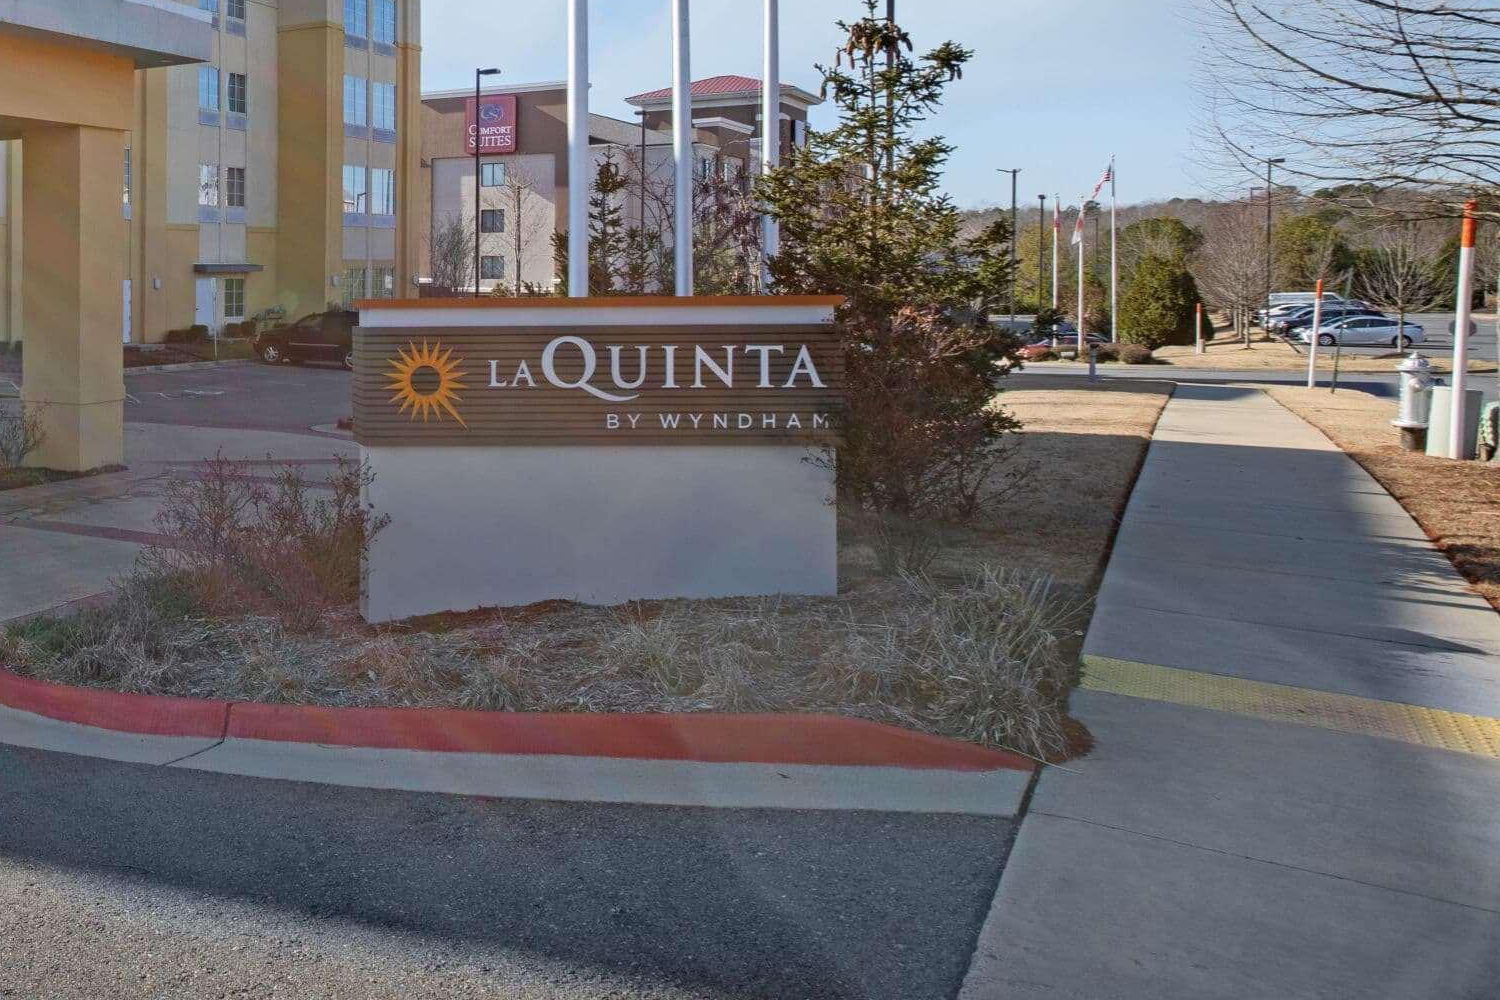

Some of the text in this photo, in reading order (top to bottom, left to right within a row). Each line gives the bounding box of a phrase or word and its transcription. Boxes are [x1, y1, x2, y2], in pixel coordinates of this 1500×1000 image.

[468, 124, 512, 135] CMFORT
[487, 336, 827, 402] LA QUINTA
[606, 413, 828, 429] BY WYNDHAM
